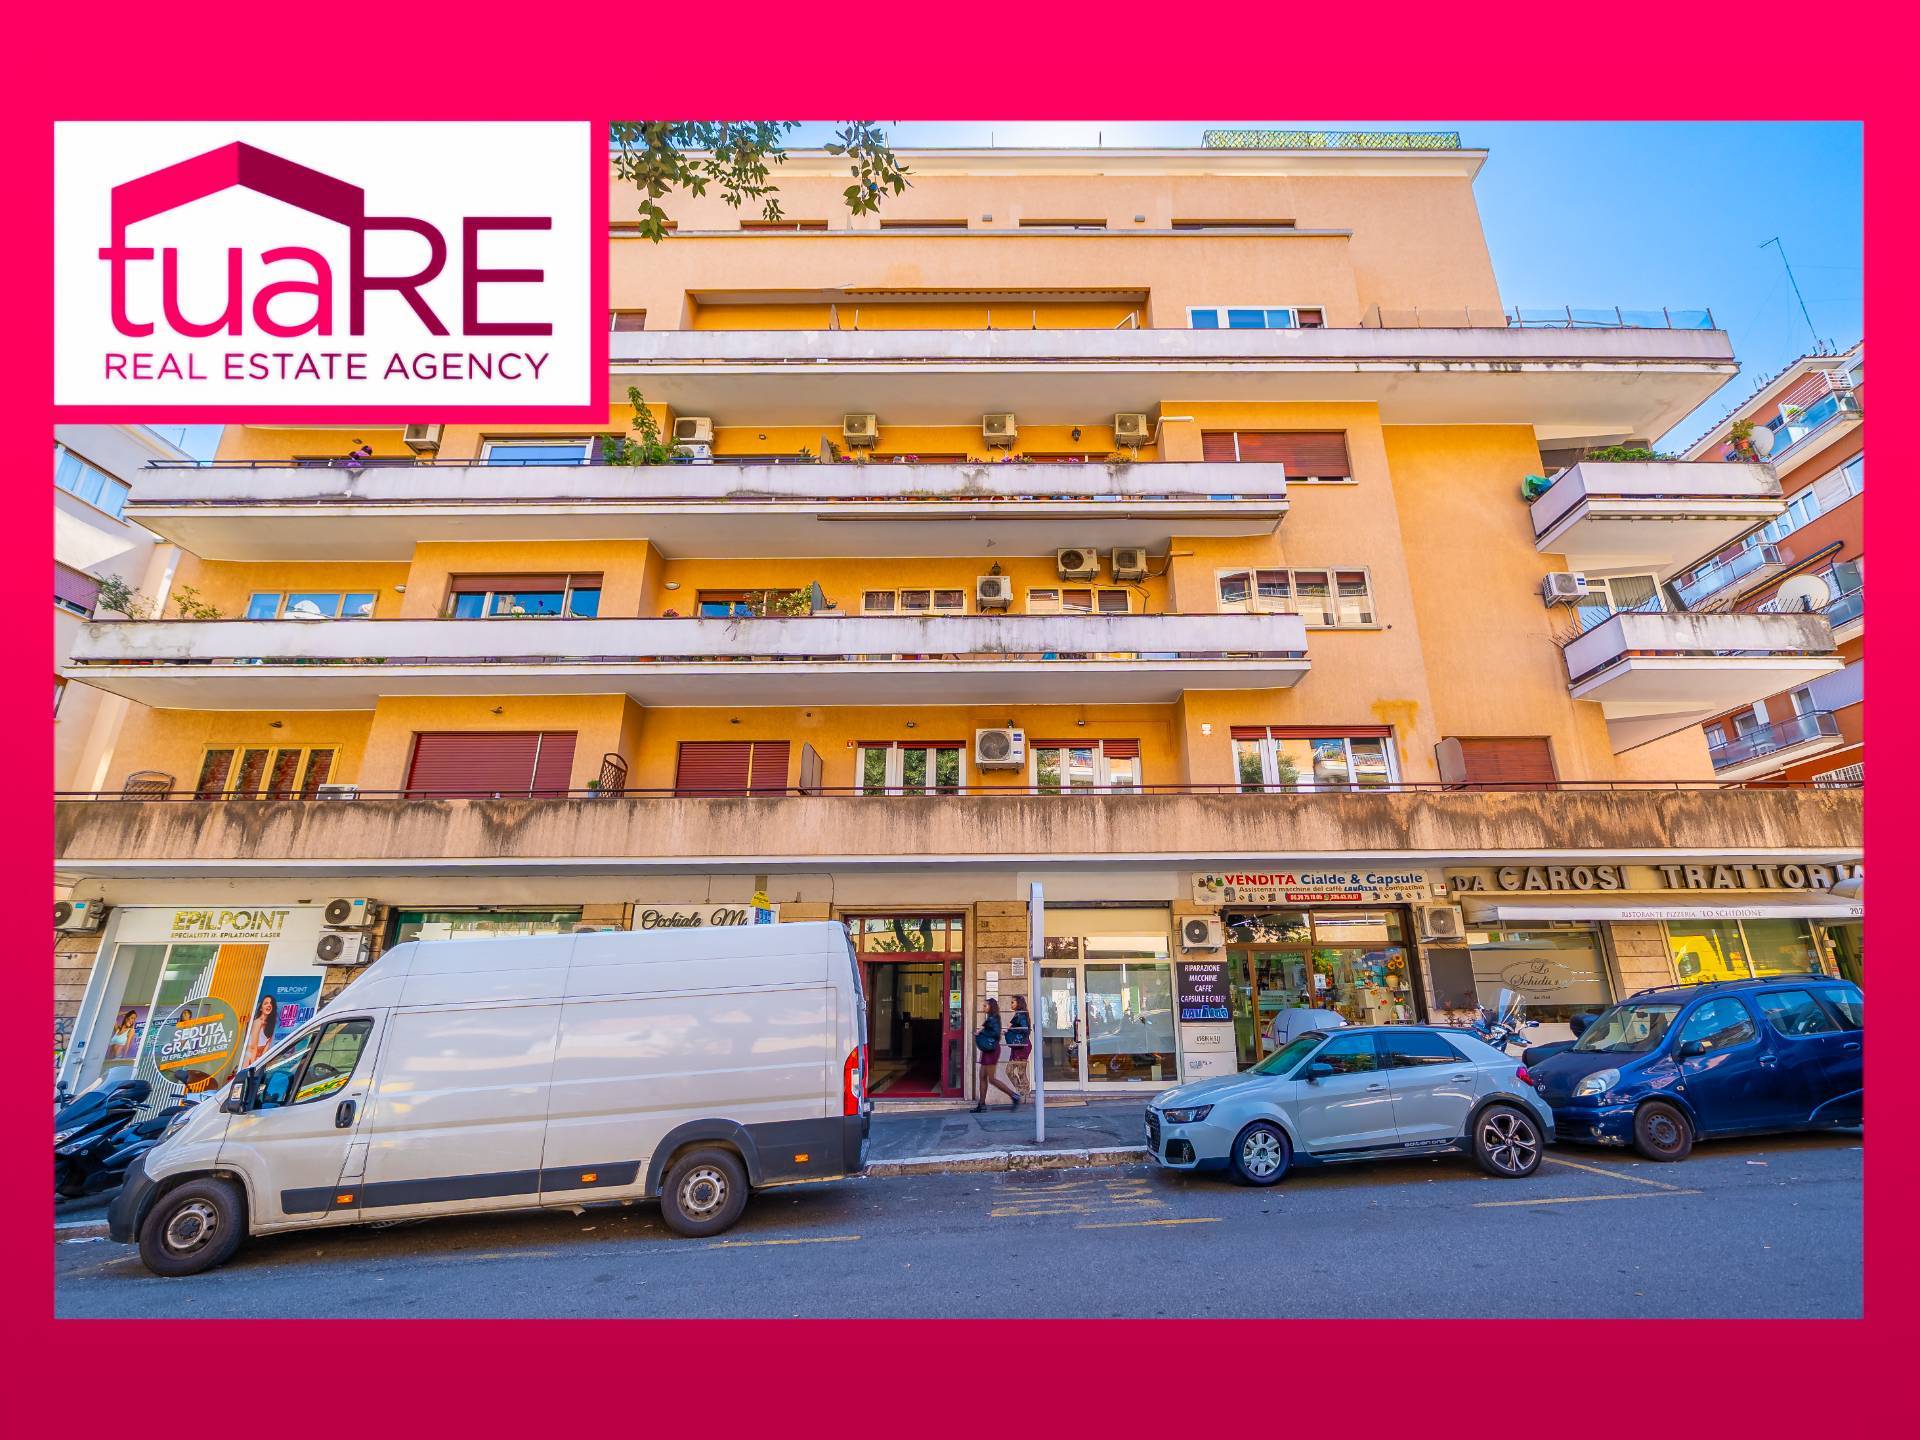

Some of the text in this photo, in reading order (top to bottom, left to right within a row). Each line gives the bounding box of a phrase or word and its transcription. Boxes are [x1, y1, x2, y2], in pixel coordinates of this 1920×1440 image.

[1225, 873, 1423, 887] VENDITA Cialde & Capsule
[1455, 876, 1485, 891] DA
[1498, 866, 1632, 891] CAROSI
[171, 911, 290, 930] EPILPOINT
[641, 909, 703, 930] Occhiale
[1666, 910, 1696, 918] PIZZERIA
[1184, 964, 1221, 972] RIPARAZIONE
[1188, 974, 1218, 982] MACCHINE
[1194, 984, 1214, 992] CAFFE'
[1180, 995, 1206, 1003] CAPSULE
[173, 1021, 225, 1042] SEDUTA
[161, 1030, 233, 1056] GRATUITA!
[169, 1048, 208, 1061] EPILAZIONE
[207, 1043, 229, 1053] LASER
